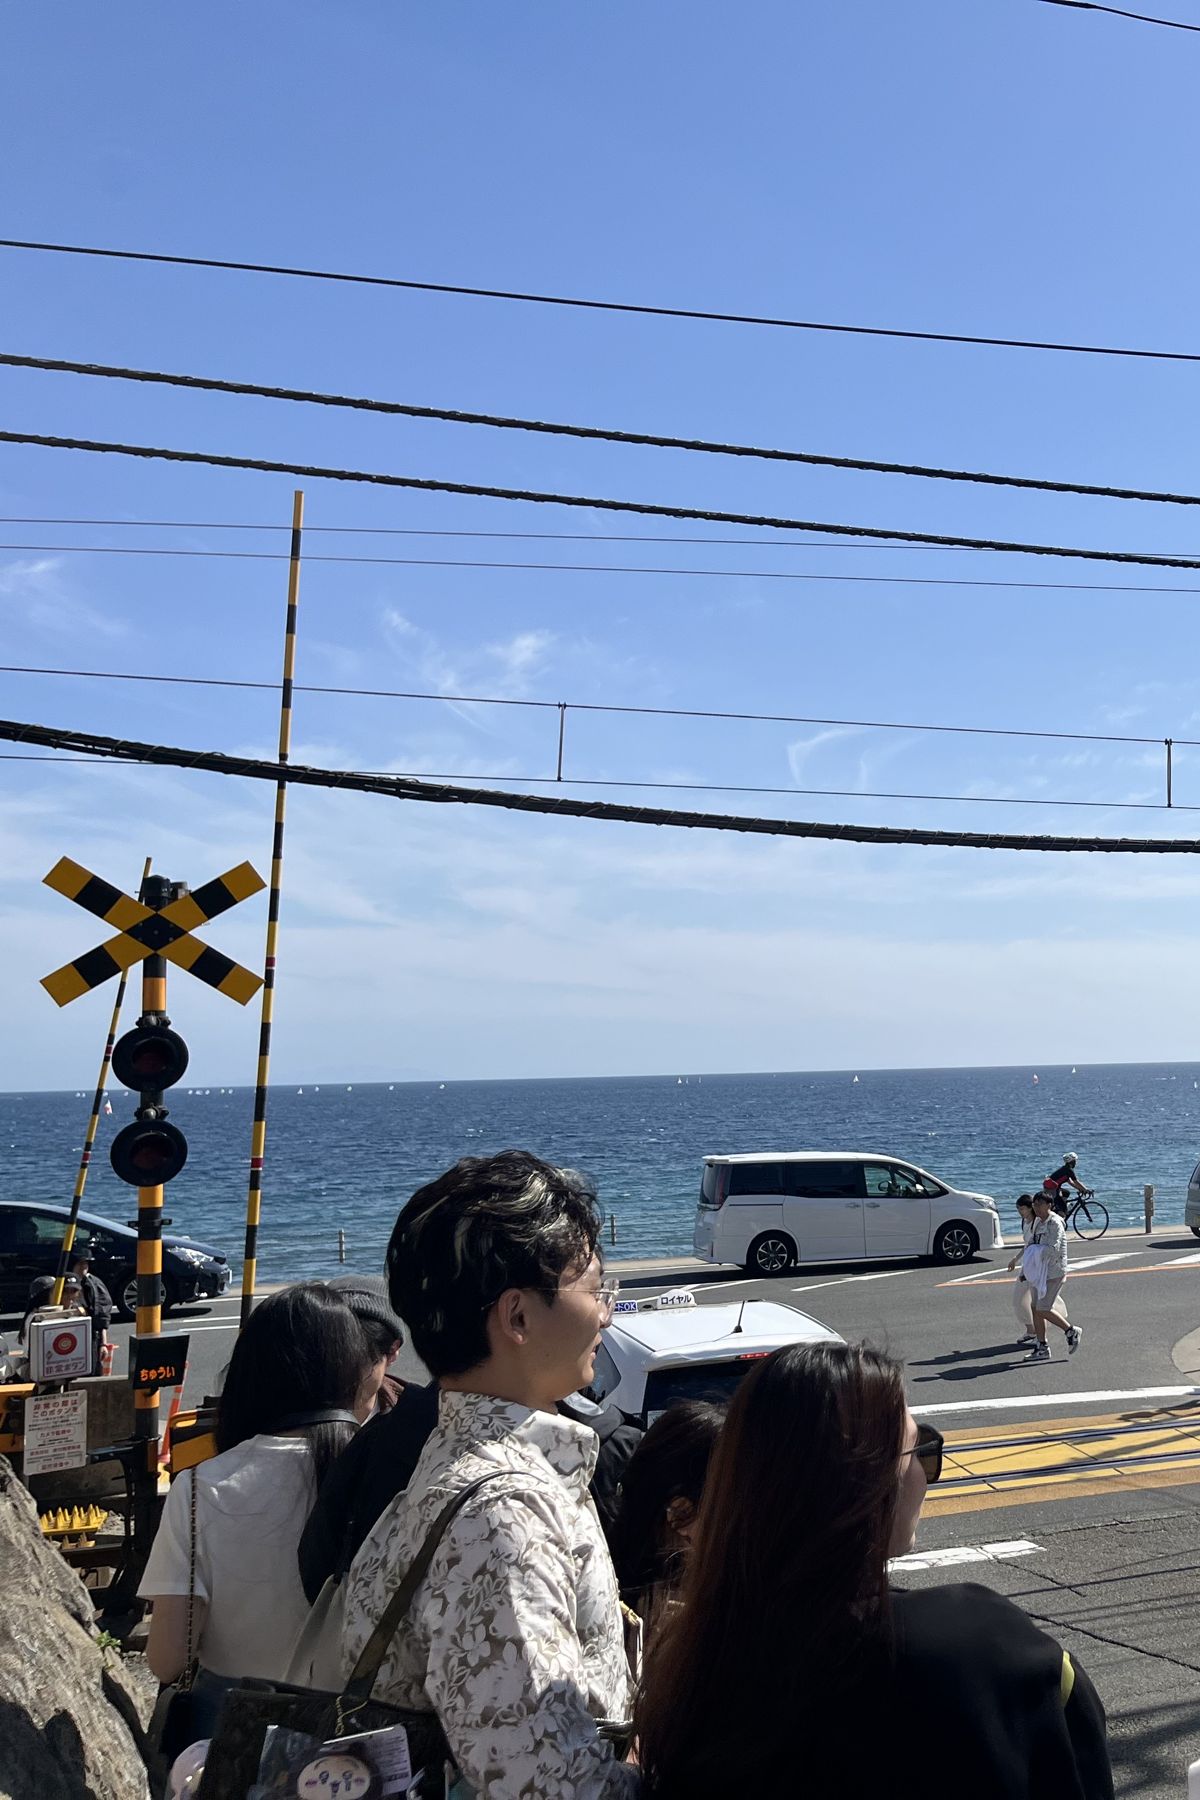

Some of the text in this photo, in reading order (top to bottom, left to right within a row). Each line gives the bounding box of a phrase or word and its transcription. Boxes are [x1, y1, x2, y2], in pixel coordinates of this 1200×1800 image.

[661, 1294, 692, 1305] ロイヤル
[140, 1366, 175, 1381] ちゅうい
[32, 1407, 78, 1419] このボタンを
